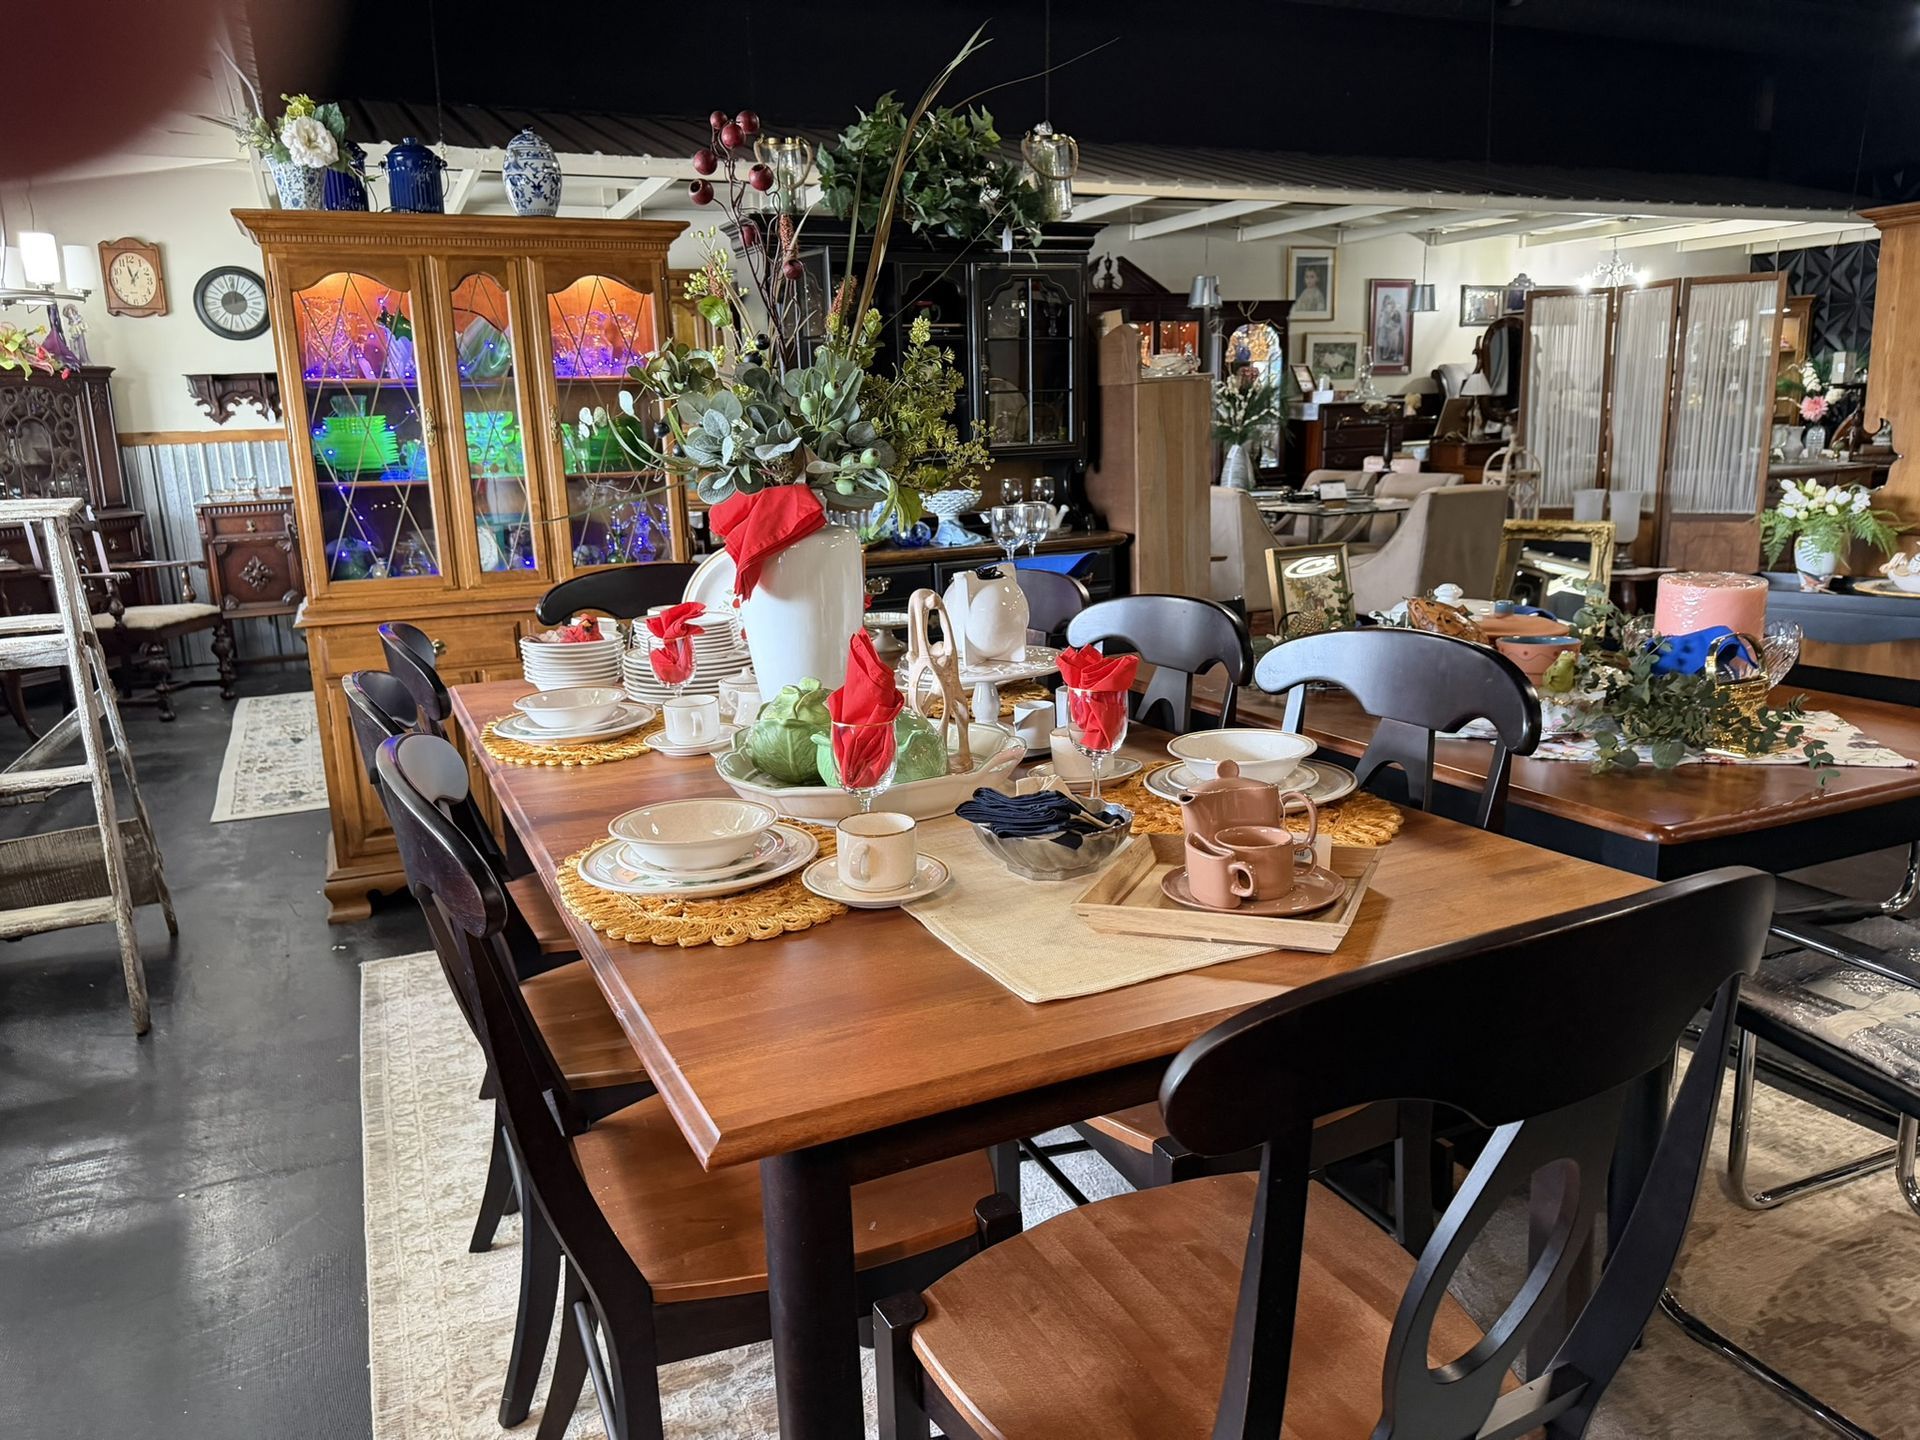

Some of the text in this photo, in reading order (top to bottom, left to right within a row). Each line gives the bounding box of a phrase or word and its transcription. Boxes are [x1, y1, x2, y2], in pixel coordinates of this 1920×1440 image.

[119, 259, 125, 267] 11
[138, 259, 142, 267] 1
[114, 268, 122, 276] 10
[144, 268, 150, 276] 2
